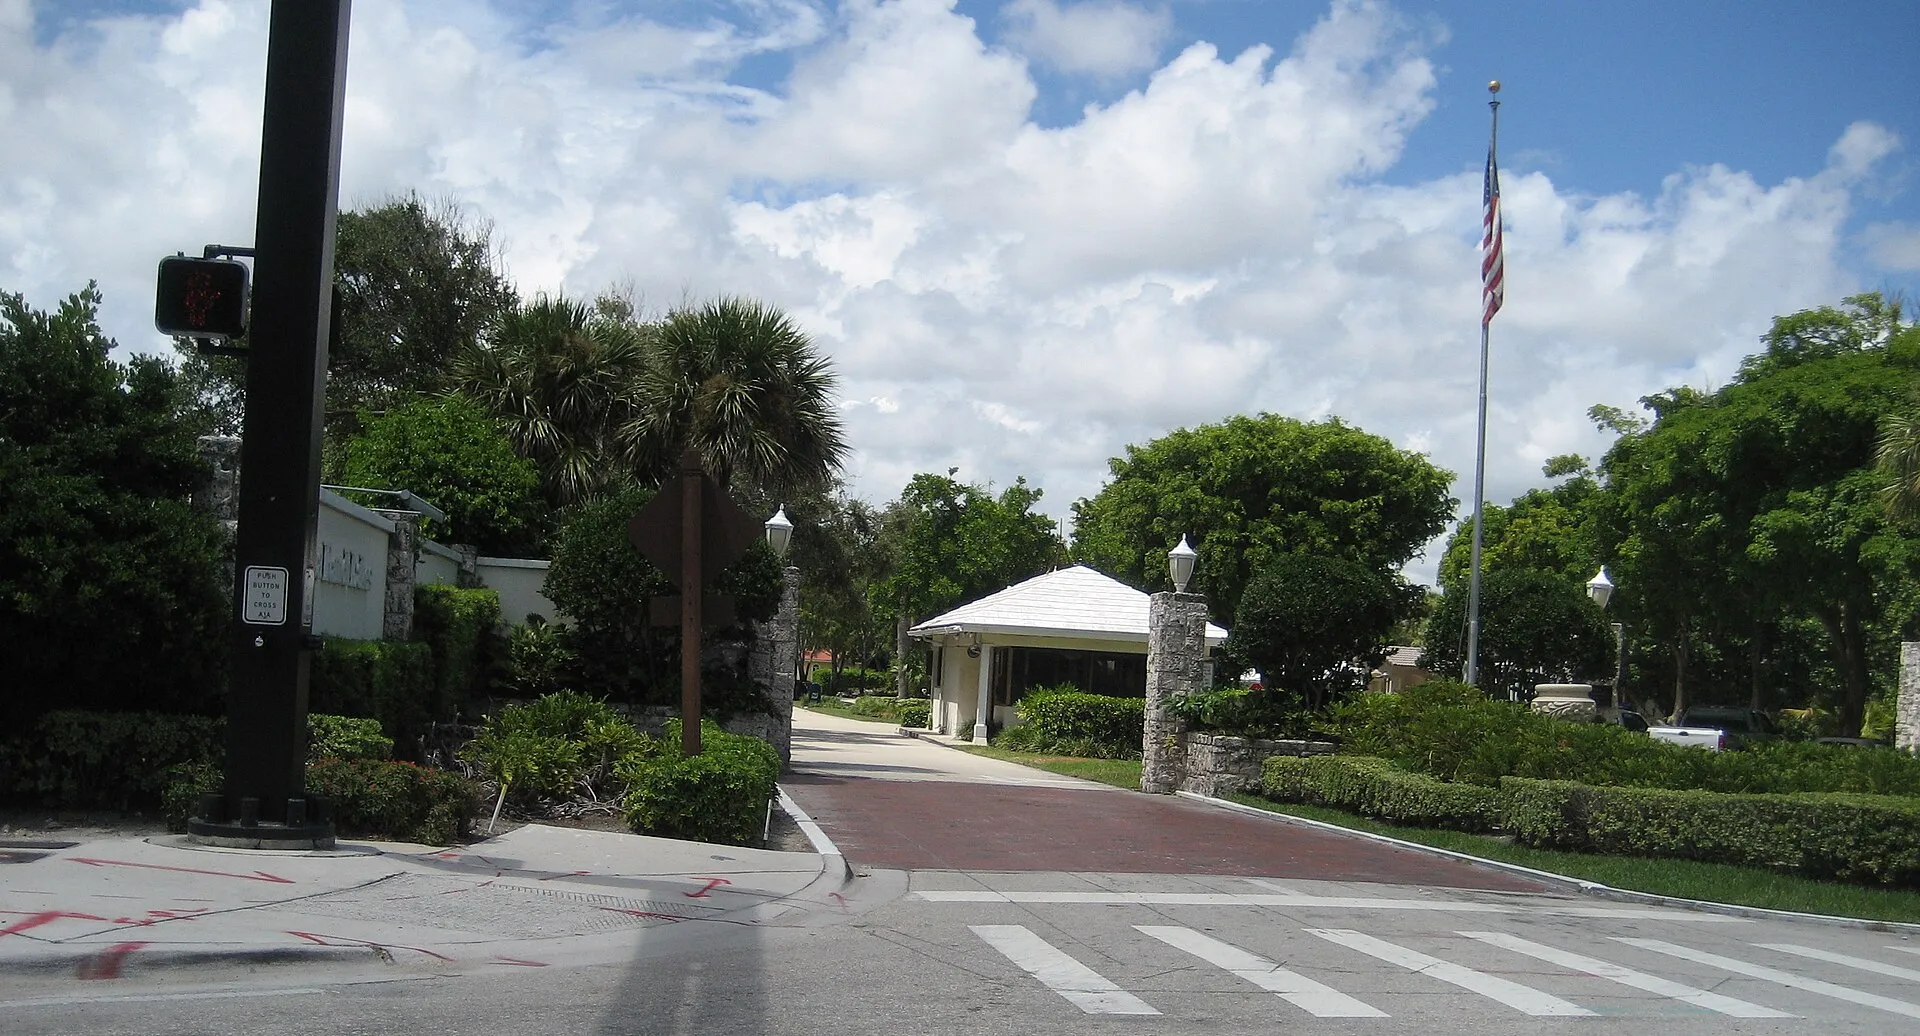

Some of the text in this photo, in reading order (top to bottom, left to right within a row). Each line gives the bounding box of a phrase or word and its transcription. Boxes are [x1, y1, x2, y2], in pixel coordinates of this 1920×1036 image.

[257, 572, 277, 580] PUSH
[252, 582, 280, 590] BUTTON
[253, 601, 277, 609] CROSS
